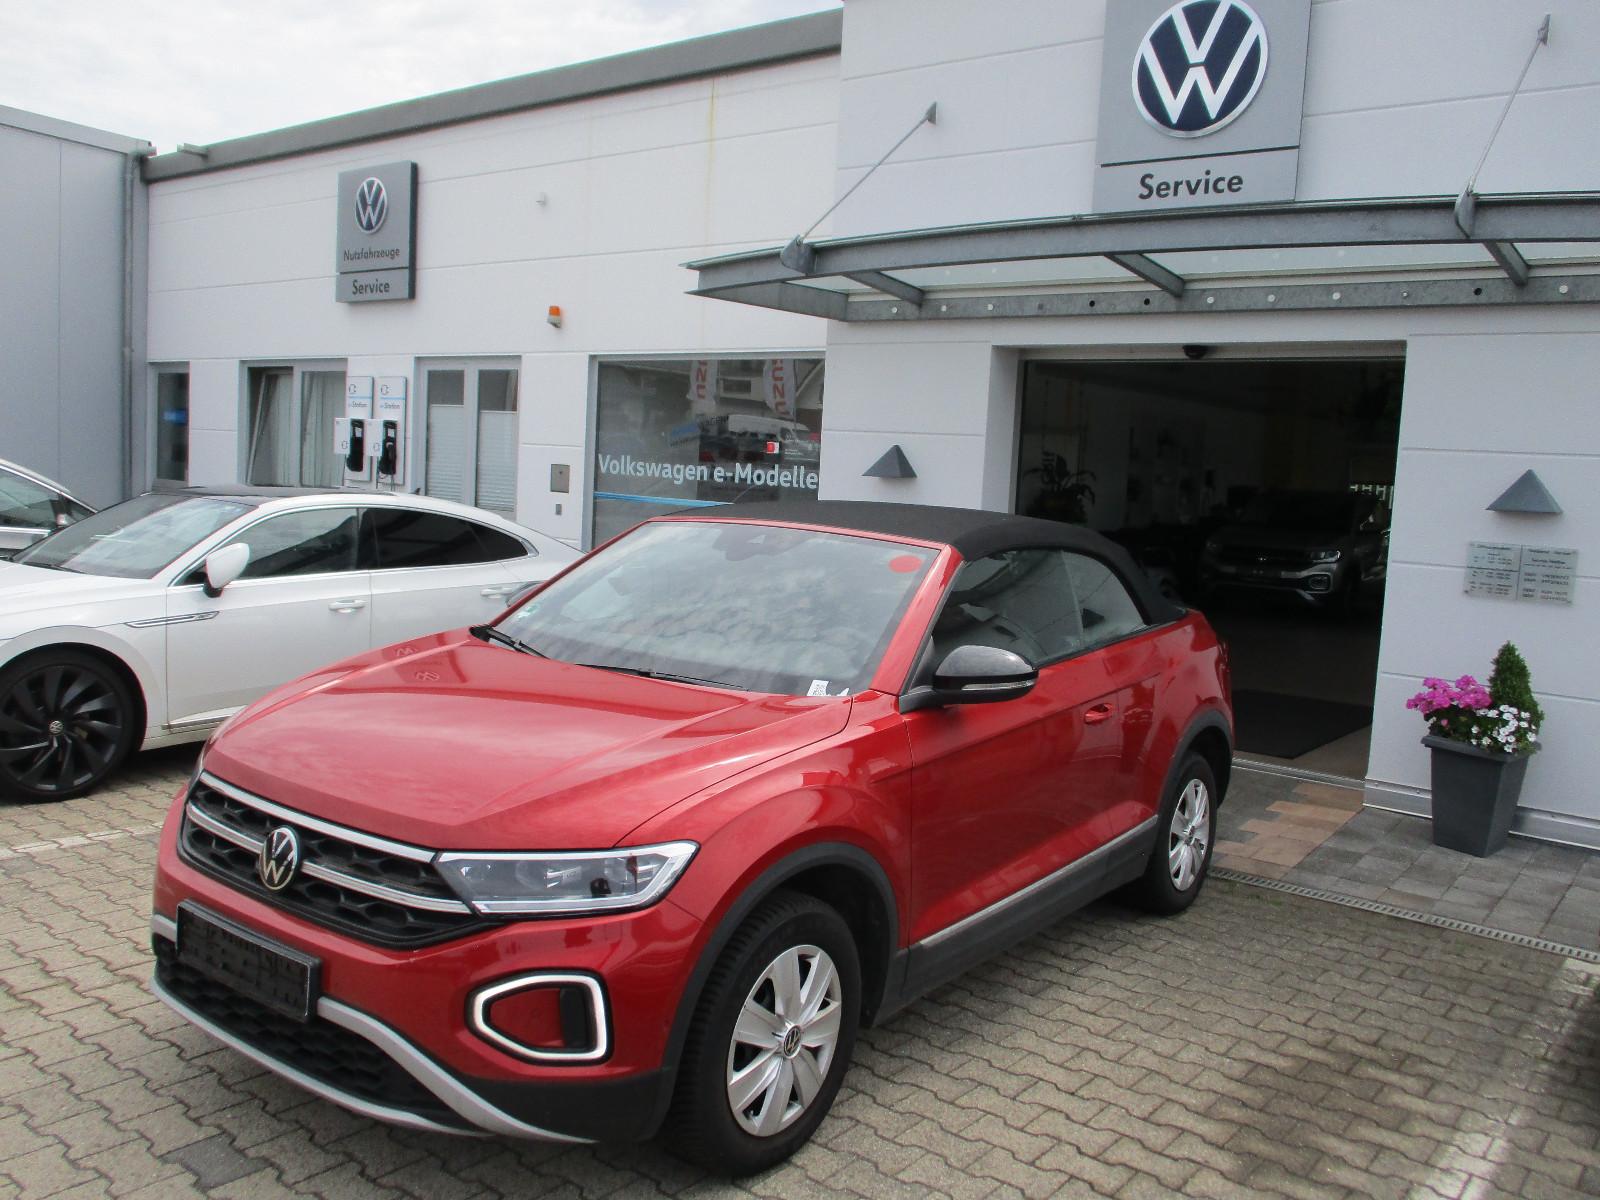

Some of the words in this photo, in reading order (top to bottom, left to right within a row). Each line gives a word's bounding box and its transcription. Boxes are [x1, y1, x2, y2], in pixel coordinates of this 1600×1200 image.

[1138, 169, 1244, 200] Service
[343, 246, 400, 262] Nutzfahrzeuge
[351, 279, 390, 296] Service
[598, 453, 708, 485] Volkswagen
[713, 462, 819, 490] e-Modelle
